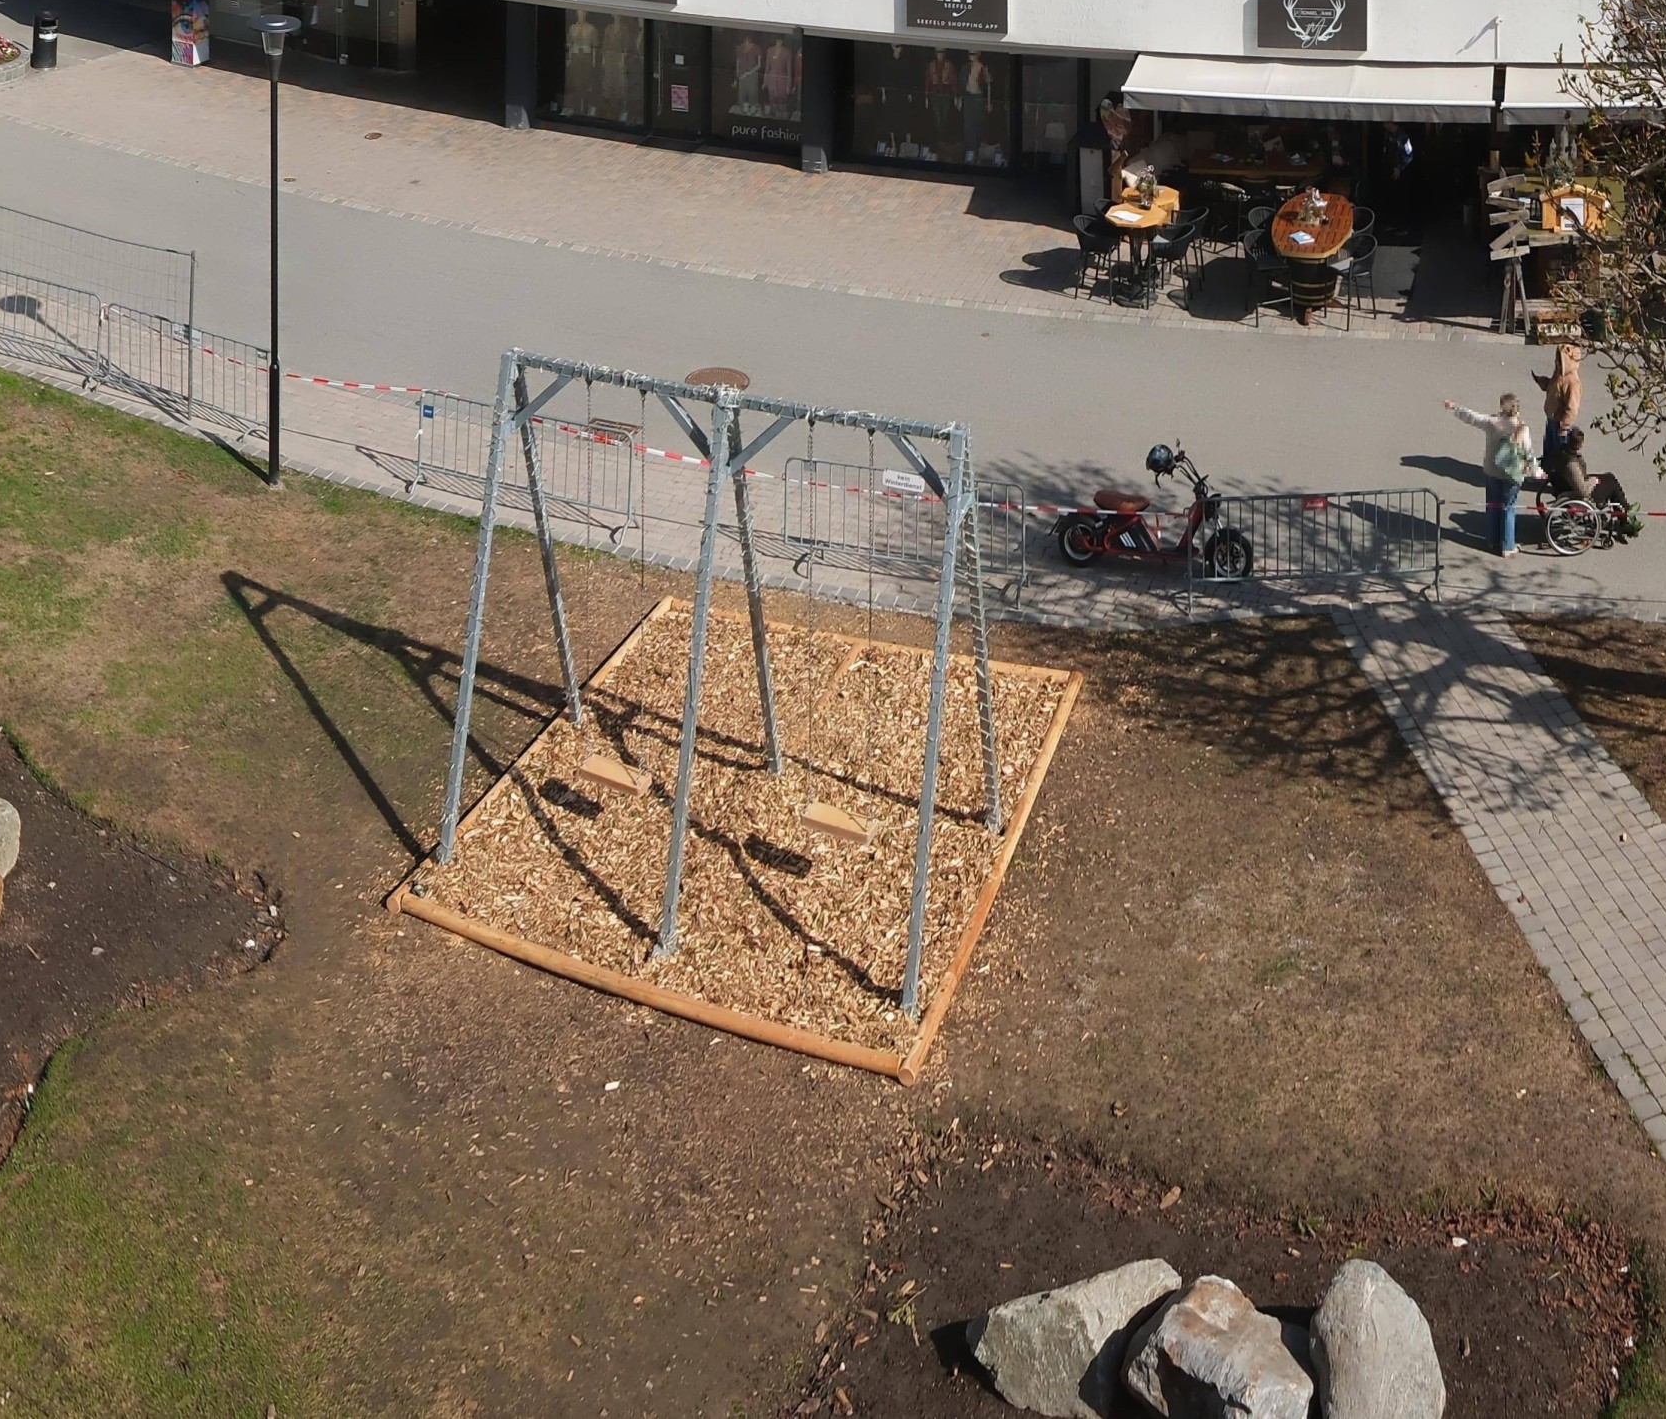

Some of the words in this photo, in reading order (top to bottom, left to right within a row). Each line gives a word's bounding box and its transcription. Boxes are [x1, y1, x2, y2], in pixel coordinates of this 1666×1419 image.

[943, 2, 973, 10] SEEFELD
[916, 18, 946, 26] SEEFELD
[947, 20, 983, 29] SHOPPING
[731, 125, 758, 136] pure
[885, 479, 923, 491] Winterdienst
